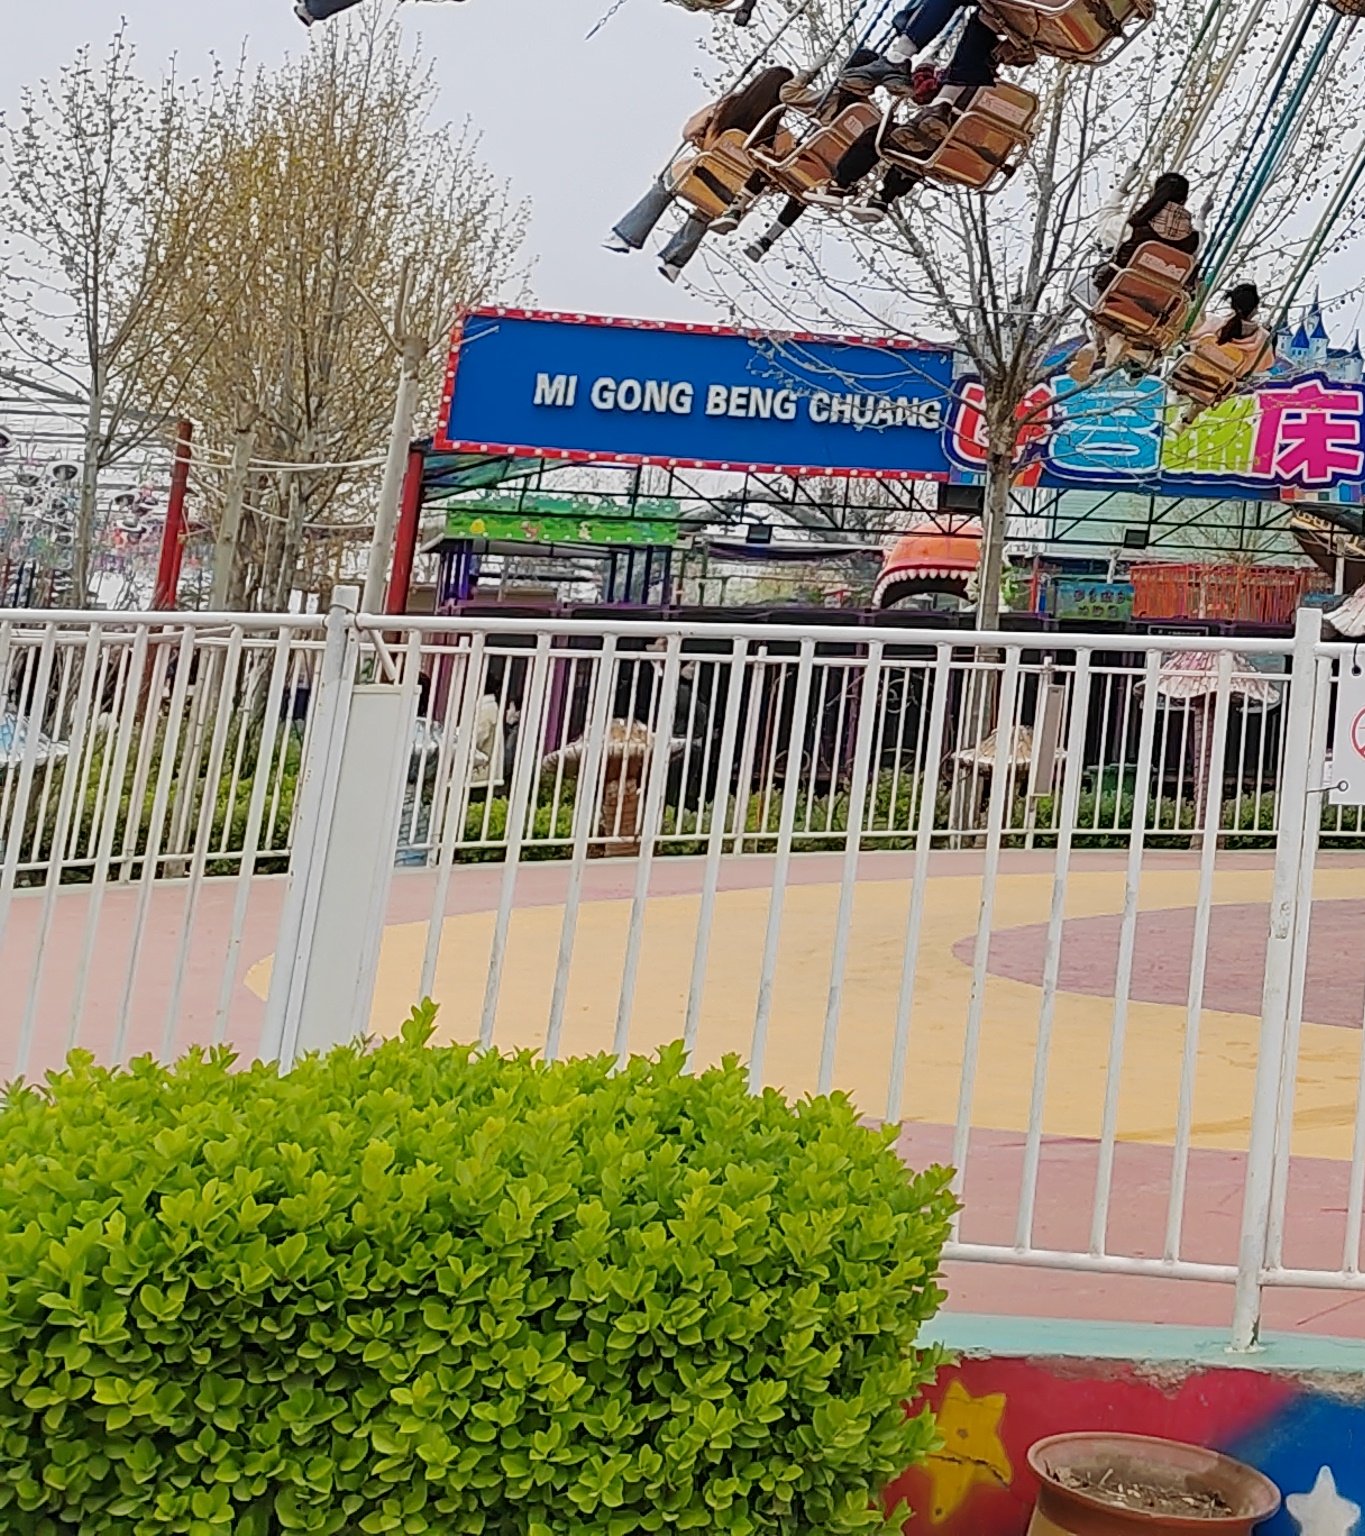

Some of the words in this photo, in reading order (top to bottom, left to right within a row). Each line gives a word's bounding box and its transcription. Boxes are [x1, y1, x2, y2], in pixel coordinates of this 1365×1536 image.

[534, 374, 575, 406] MI
[591, 377, 690, 414] GONG
[705, 385, 796, 419] BENG
[810, 394, 941, 431] CHUANG
